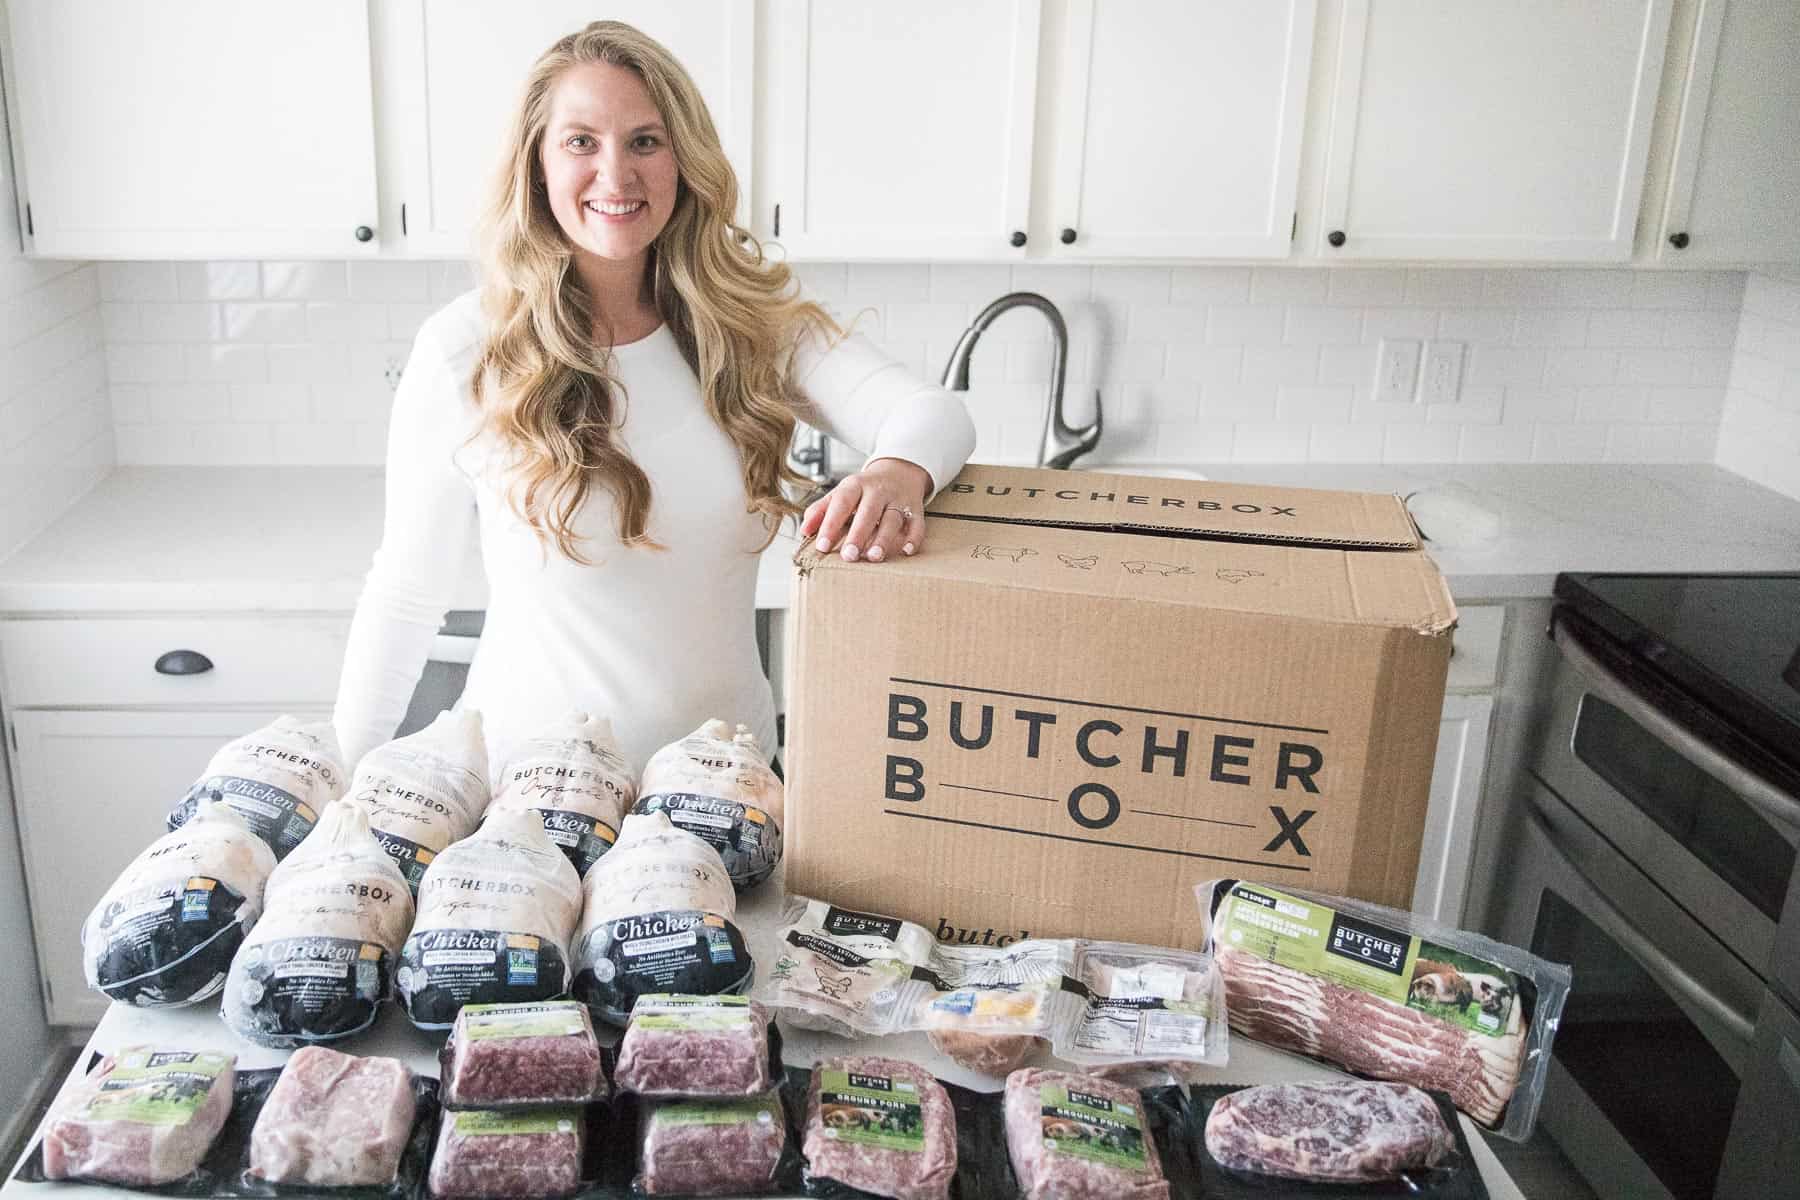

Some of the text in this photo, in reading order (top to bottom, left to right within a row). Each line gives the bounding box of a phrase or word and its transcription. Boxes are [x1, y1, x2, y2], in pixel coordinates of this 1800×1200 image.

[951, 483, 1297, 517] BUTCHERBOX
[887, 692, 1324, 794] BUTCHER
[223, 778, 295, 811] Chicken
[666, 794, 745, 818] Chicken
[544, 812, 591, 834] cken
[612, 913, 703, 941] Chicken
[270, 939, 357, 961] Chicken
[420, 931, 505, 951] Chicken
[1336, 928, 1402, 957] BUTCHER
[836, 1094, 906, 1110] GROUND PORK
[1056, 1107, 1097, 1123] GROUND
